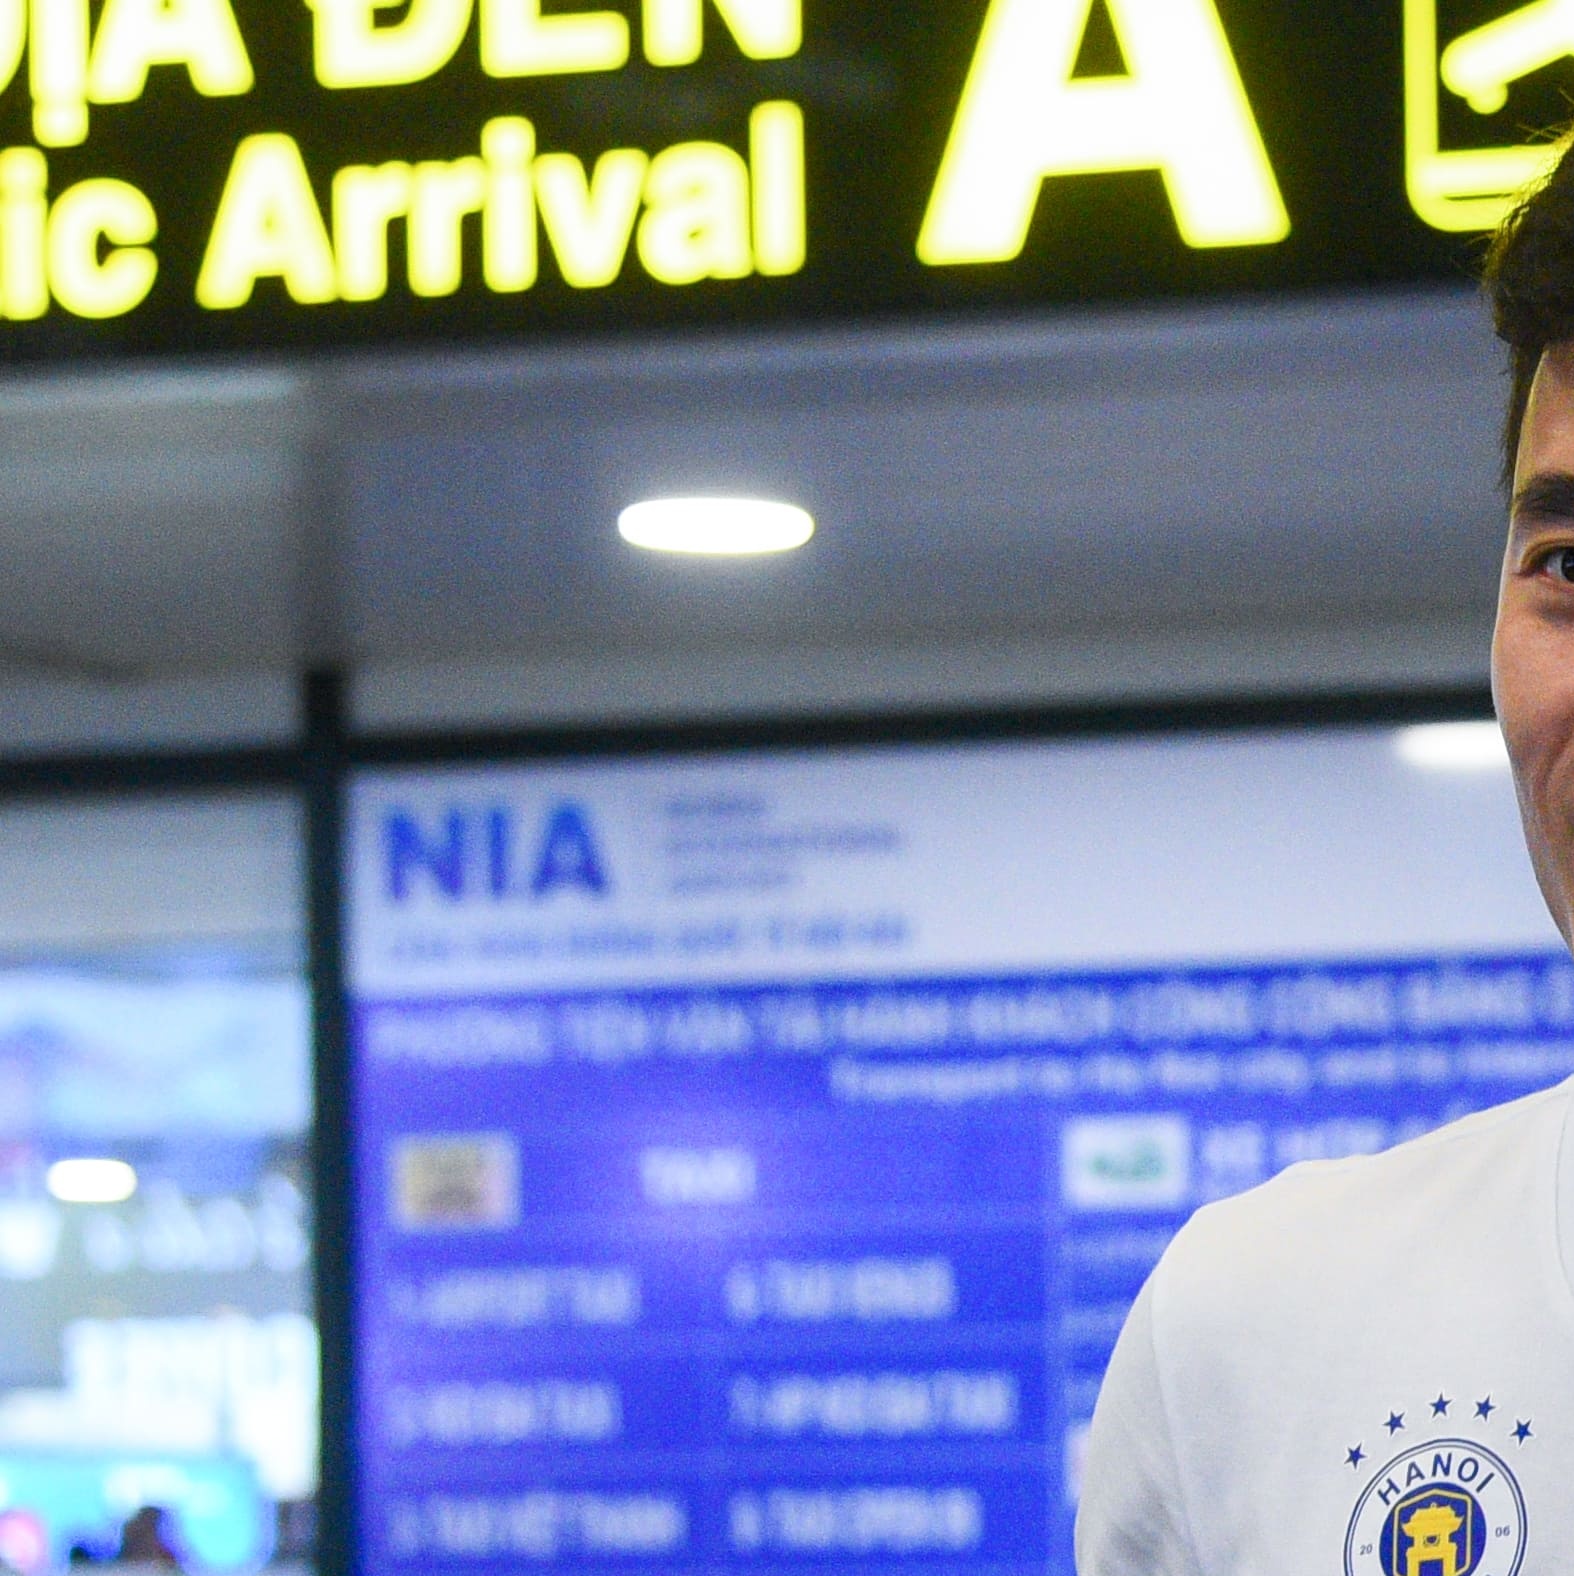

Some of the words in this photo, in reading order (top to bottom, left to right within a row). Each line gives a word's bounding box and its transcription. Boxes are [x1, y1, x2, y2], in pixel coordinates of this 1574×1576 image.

[915, 0, 1291, 265] A
[195, 100, 806, 310] Arrival
[383, 798, 608, 899] NIA
[1376, 1452, 1495, 1506] HANOI
[1495, 1525, 1511, 1538] 06
